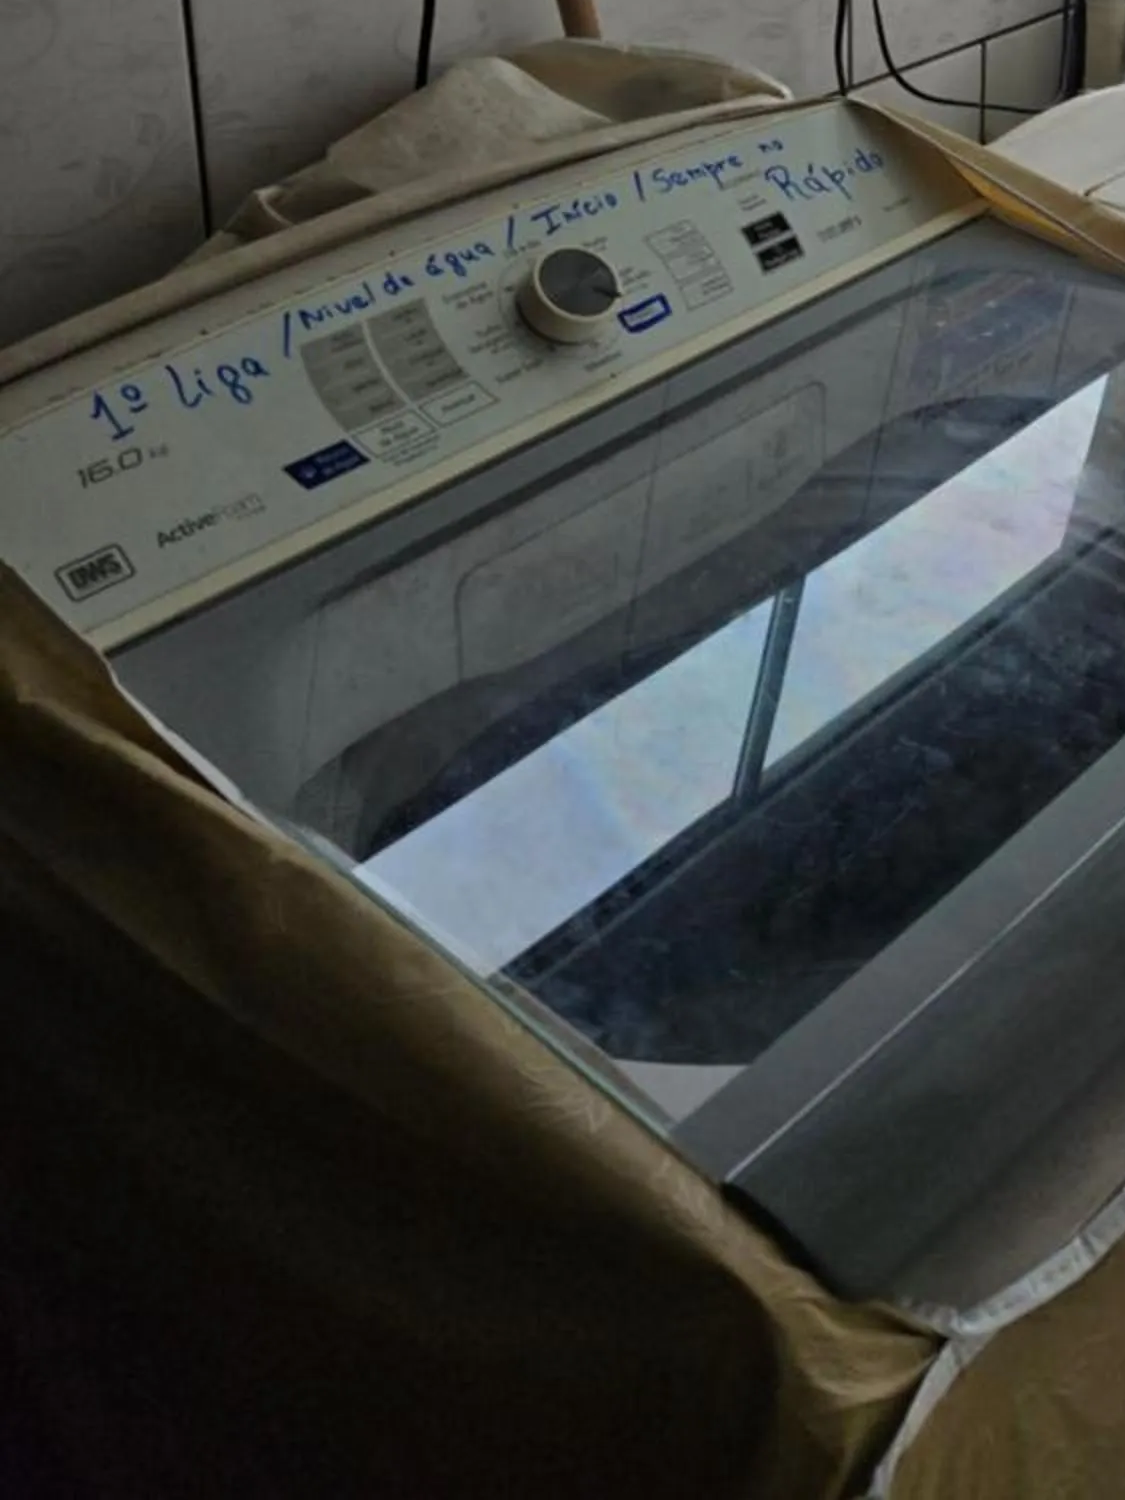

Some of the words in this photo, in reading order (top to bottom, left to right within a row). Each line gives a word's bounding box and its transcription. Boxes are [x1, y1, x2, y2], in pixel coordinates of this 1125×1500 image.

[763, 147, 885, 201] Rápido
[165, 357, 271, 409] Liga
[652, 154, 743, 191] Sempre
[77, 447, 143, 488] 16.0
